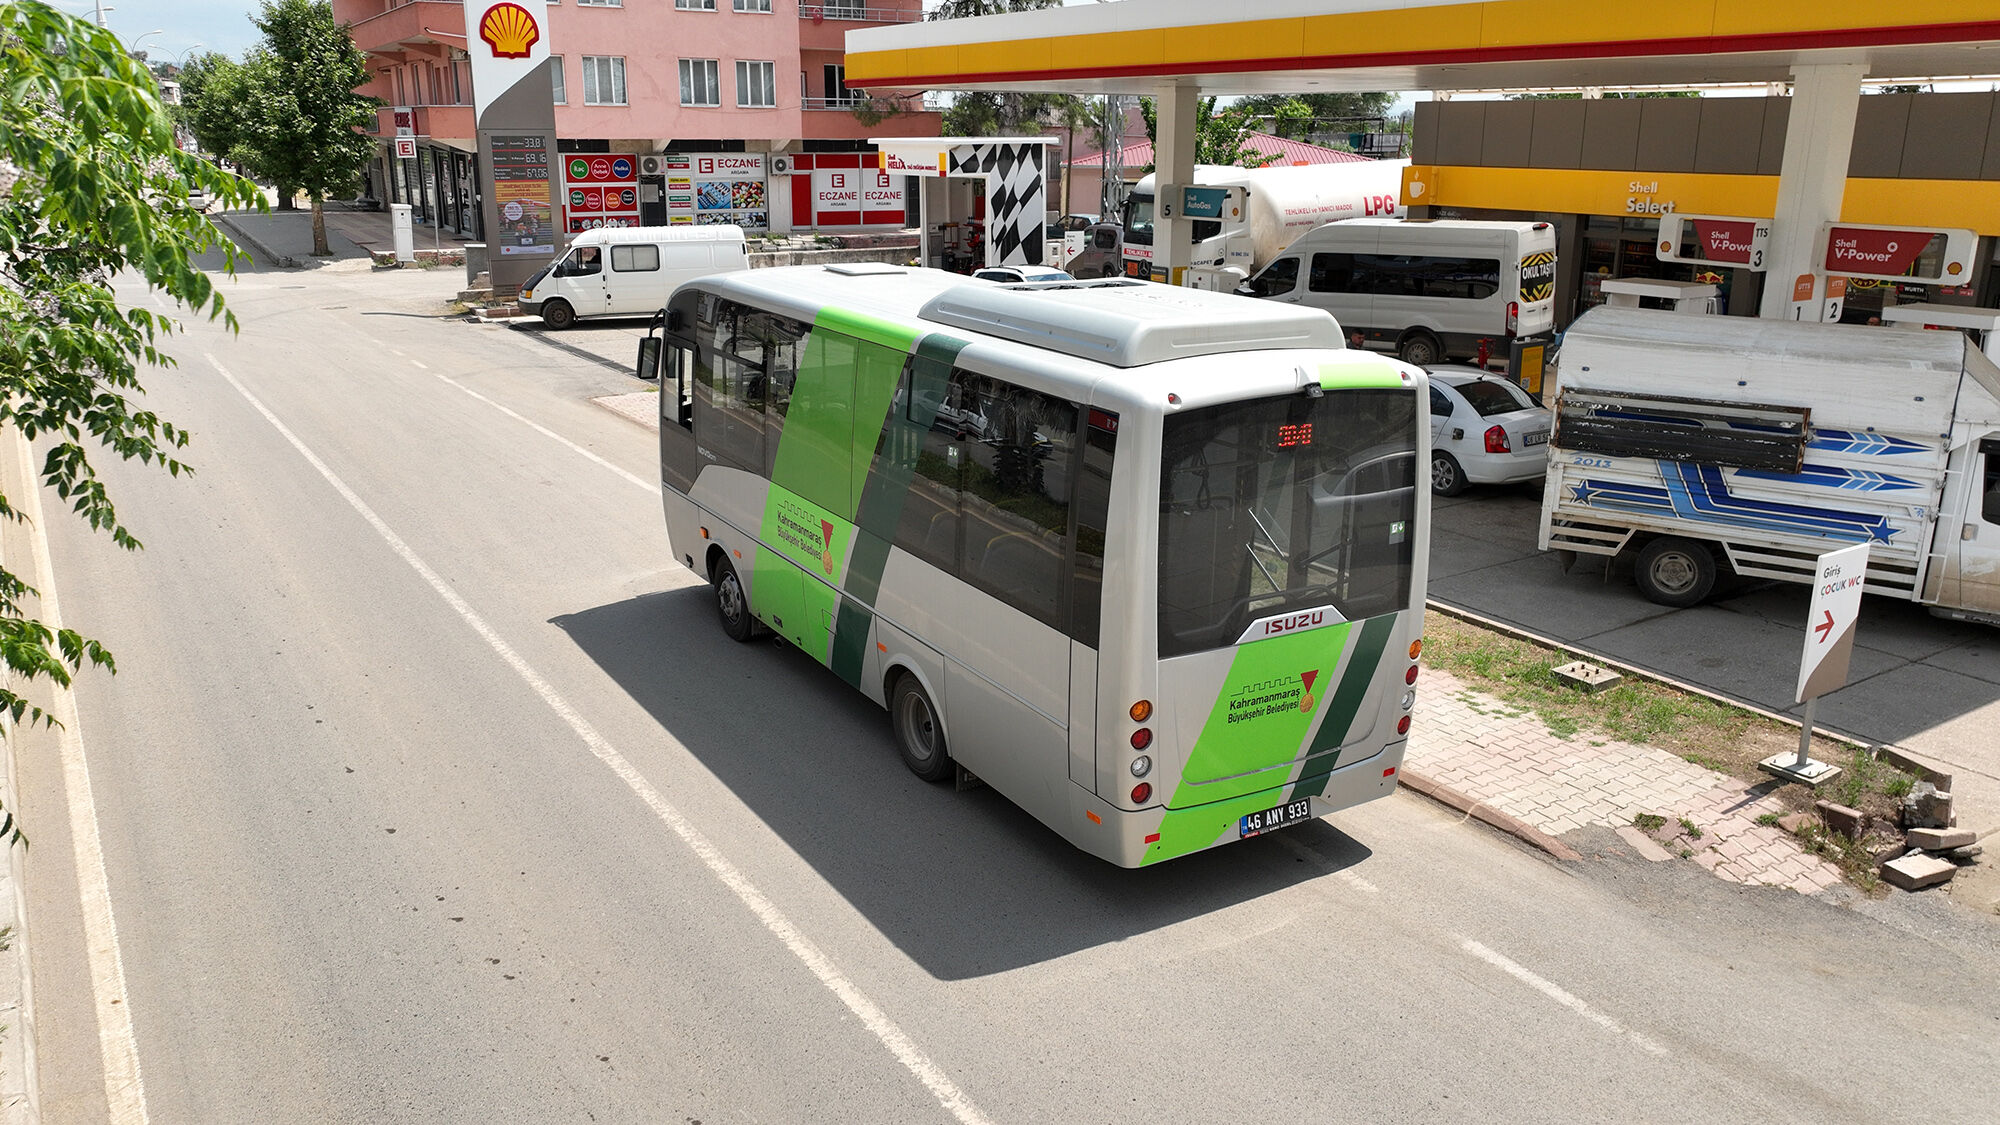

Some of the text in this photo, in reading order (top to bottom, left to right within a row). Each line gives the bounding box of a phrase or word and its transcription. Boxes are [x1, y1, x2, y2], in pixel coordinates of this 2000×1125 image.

[700, 159, 713, 173] E
[717, 158, 761, 169] ECZANE
[888, 158, 906, 170] HELIX
[833, 174, 844, 187] E
[878, 174, 889, 187] E
[1629, 181, 1658, 194] Shell
[819, 191, 858, 201] ECZANE
[865, 191, 902, 200] ECZANE
[1164, 204, 1172, 217] 5
[1187, 202, 1212, 210] AutoGas
[1363, 194, 1395, 217] LPG
[1626, 197, 1675, 215] Select
[1711, 231, 1730, 240] Shell
[1756, 228, 1769, 238] TTS
[1711, 240, 1752, 253] V-Powe
[1835, 239, 1857, 249] Shell
[1753, 249, 1763, 268] 3
[1835, 248, 1892, 262] V-Power
[1522, 264, 1540, 280] OKUL
[1796, 306, 1802, 321] 1
[1829, 302, 1838, 319] 2
[1573, 456, 1612, 469] 2013
[777, 510, 822, 548] Kahramanmaraş
[777, 525, 822, 561] Büyükşehir Belediyesi
[1823, 565, 1841, 579] Giriş
[1820, 575, 1861, 600] ÇOCUK WC
[1265, 611, 1323, 635] ISUZU
[1229, 688, 1300, 711] Kahramanmaraş
[1227, 698, 1300, 724] Büyükşehir Belediyesi
[1248, 813, 1261, 830] 46
[1266, 807, 1284, 826] ANY
[1288, 800, 1309, 819] 933
